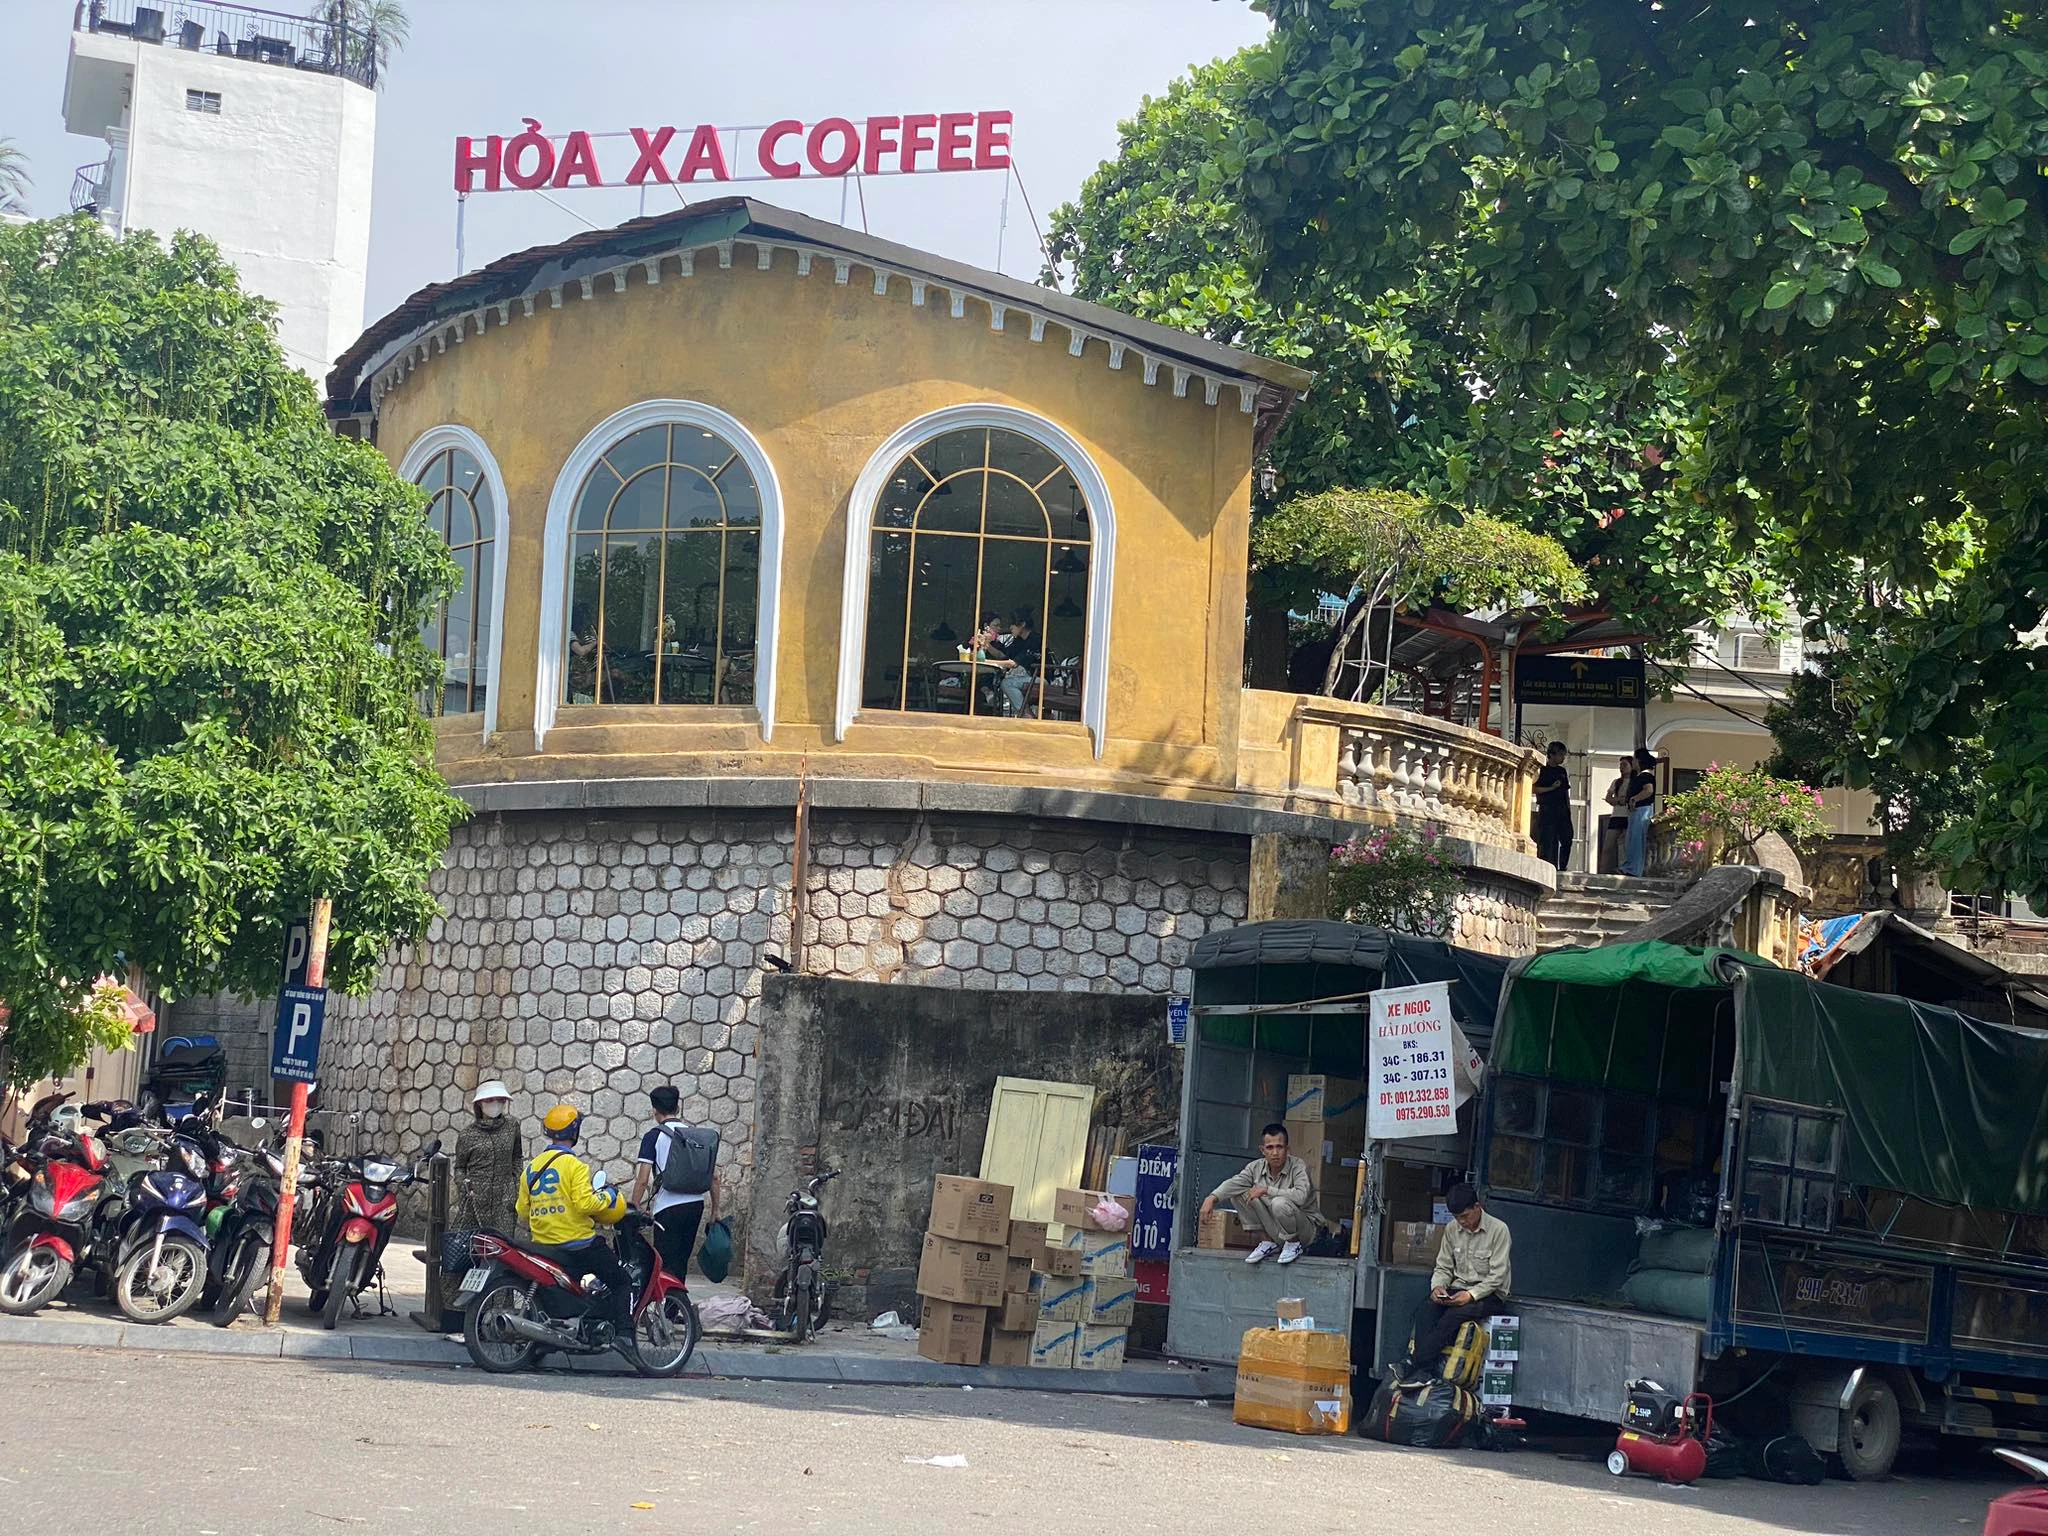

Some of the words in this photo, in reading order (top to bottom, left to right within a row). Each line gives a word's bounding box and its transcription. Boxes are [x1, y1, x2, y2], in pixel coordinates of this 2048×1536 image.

[454, 117, 601, 191] HỎA
[625, 124, 733, 185] XA
[758, 109, 1013, 179] COFFEE
[285, 925, 307, 983] P
[1387, 1003, 1401, 1017] XE
[1404, 999, 1431, 1016] NGỌC
[287, 1003, 311, 1054] P
[1400, 1020, 1441, 1034] DƯƠNG
[1402, 1040, 1418, 1049] BKS:
[1382, 1055, 1400, 1067] 34C
[1410, 1050, 1445, 1064] 186.31
[1383, 1072, 1401, 1084] 34C
[1410, 1068, 1447, 1082] 307.13
[1394, 1087, 1449, 1104] 0912.332.858
[1396, 1104, 1450, 1121] 0975.290.530
[1139, 1152, 1171, 1178] ĐIỂM
[526, 1164, 560, 1196] be
[1133, 1218, 1140, 1248] Ô
[1144, 1220, 1158, 1250] TÔ
